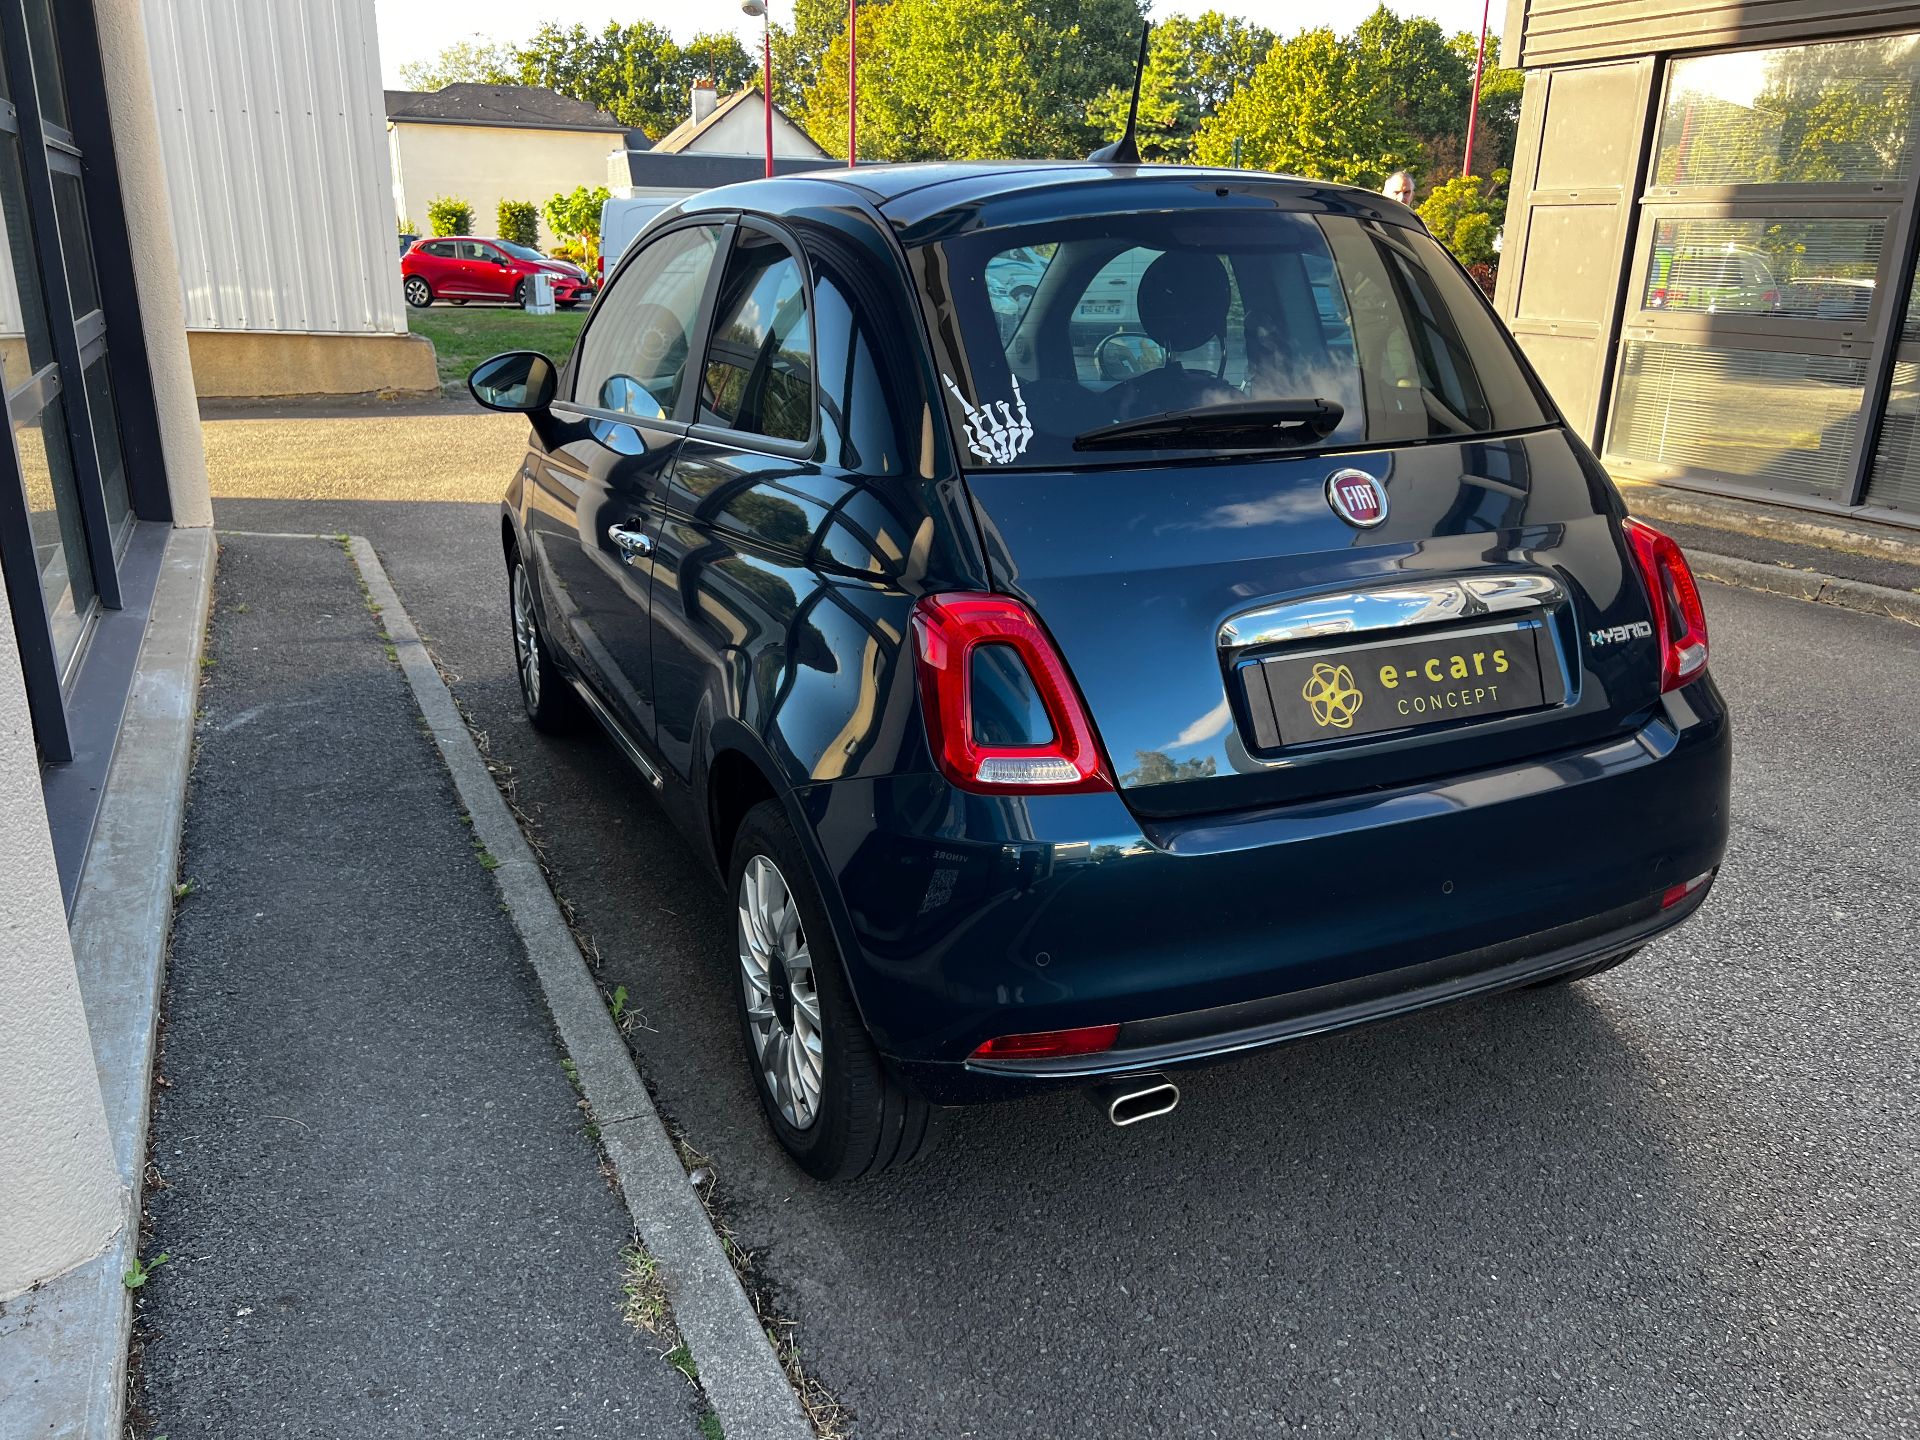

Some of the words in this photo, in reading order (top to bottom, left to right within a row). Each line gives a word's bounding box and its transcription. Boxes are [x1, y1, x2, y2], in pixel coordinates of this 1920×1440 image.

[1341, 484, 1377, 512] FIAT
[1588, 621, 1652, 647] HYBRID
[1379, 648, 1510, 689] e-cars
[1397, 685, 1500, 715] CONCEPT
